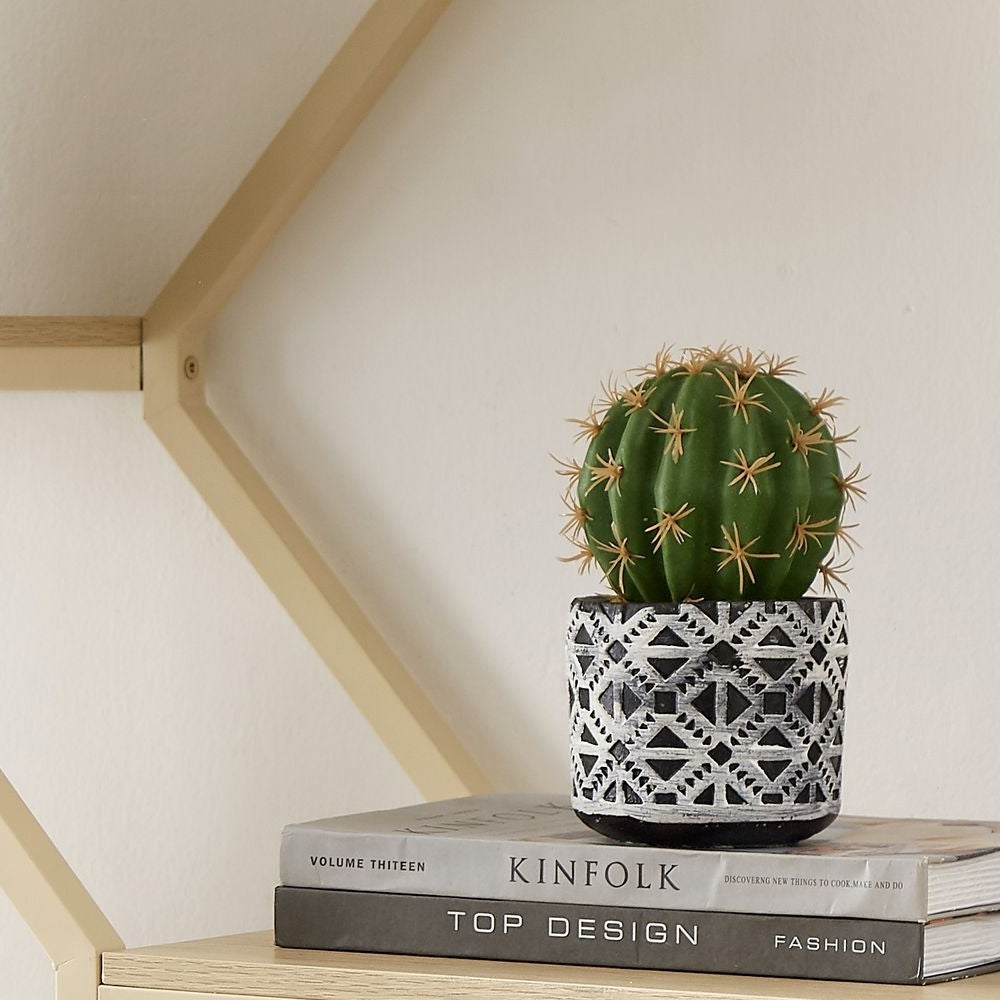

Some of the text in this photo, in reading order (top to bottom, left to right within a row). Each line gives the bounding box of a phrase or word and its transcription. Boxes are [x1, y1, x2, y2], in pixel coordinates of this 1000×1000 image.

[310, 856, 426, 872] VOLUME THITEEN
[509, 856, 681, 891] KINFOLK
[772, 876, 788, 886] NEW
[790, 877, 817, 887] THINGS
[819, 878, 829, 887] TO
[874, 880, 891, 889] AND
[892, 881, 904, 890] DO
[447, 910, 699, 945] TOP DESIGN
[774, 935, 887, 955] FASHION
